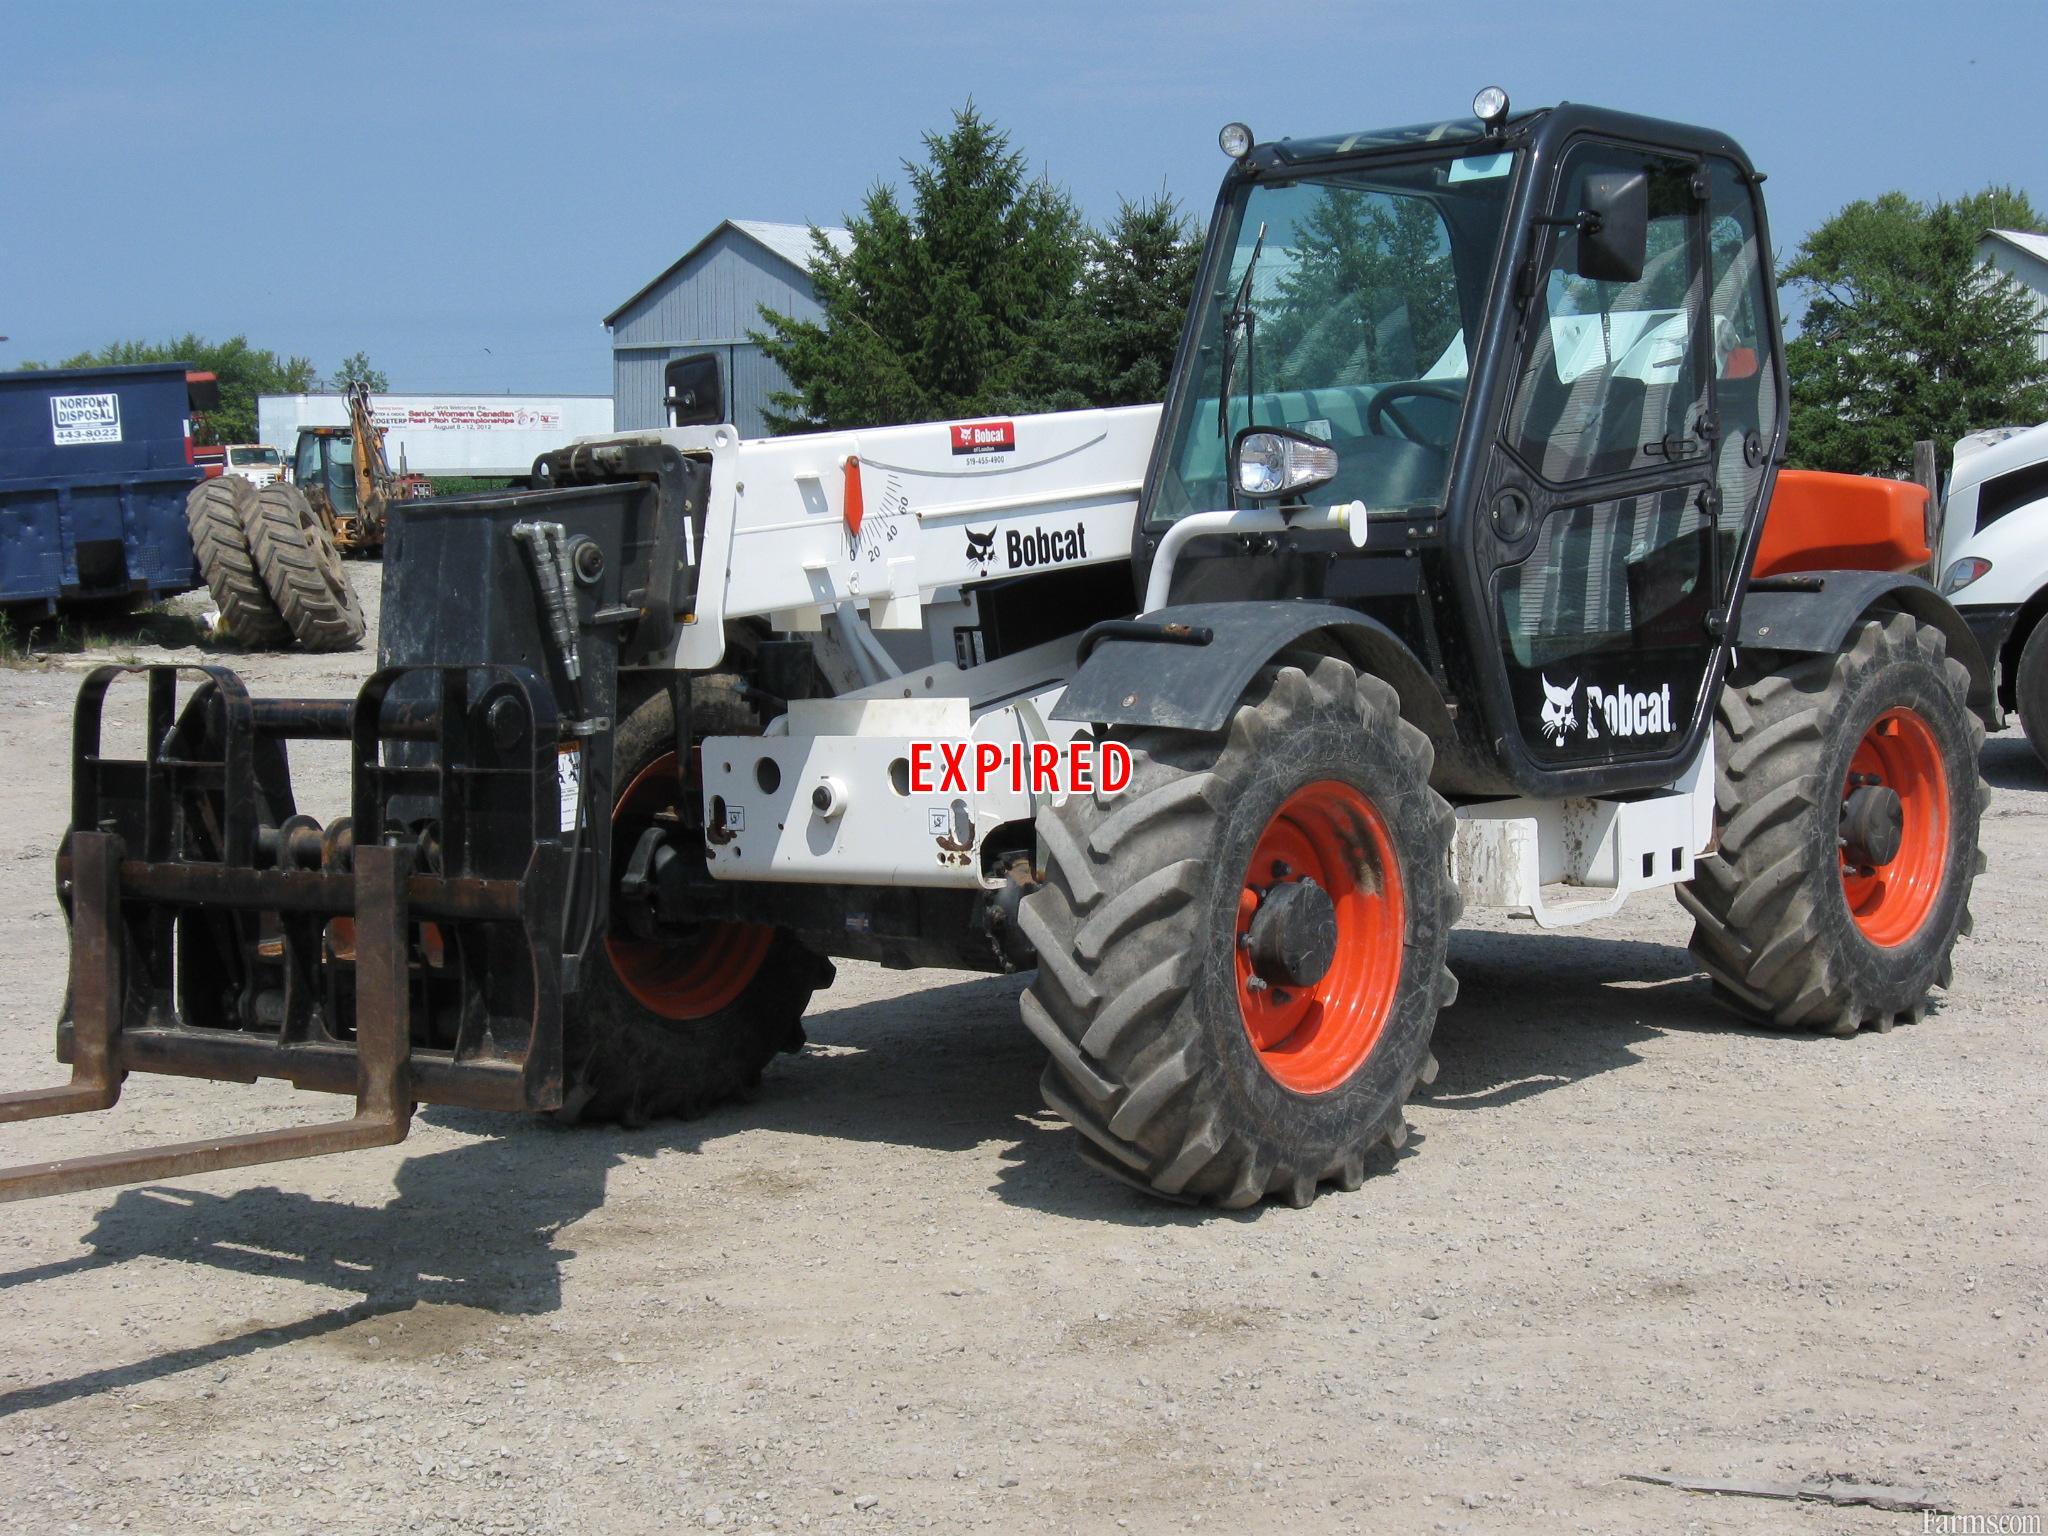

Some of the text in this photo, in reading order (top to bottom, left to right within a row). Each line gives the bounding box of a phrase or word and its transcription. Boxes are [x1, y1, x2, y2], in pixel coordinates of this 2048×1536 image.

[59, 396, 109, 409] NORFOLK
[59, 409, 113, 422] DISPOSAL
[451, 417, 515, 425] Championships
[57, 429, 118, 439] 443-8022
[974, 428, 1005, 443] Bobcat
[966, 456, 1005, 466] 519-455-4900
[898, 496, 909, 515] 60
[886, 525, 898, 542] 40
[1006, 522, 1087, 569] Bobcat
[849, 548, 856, 561] 0
[868, 545, 881, 562] 20
